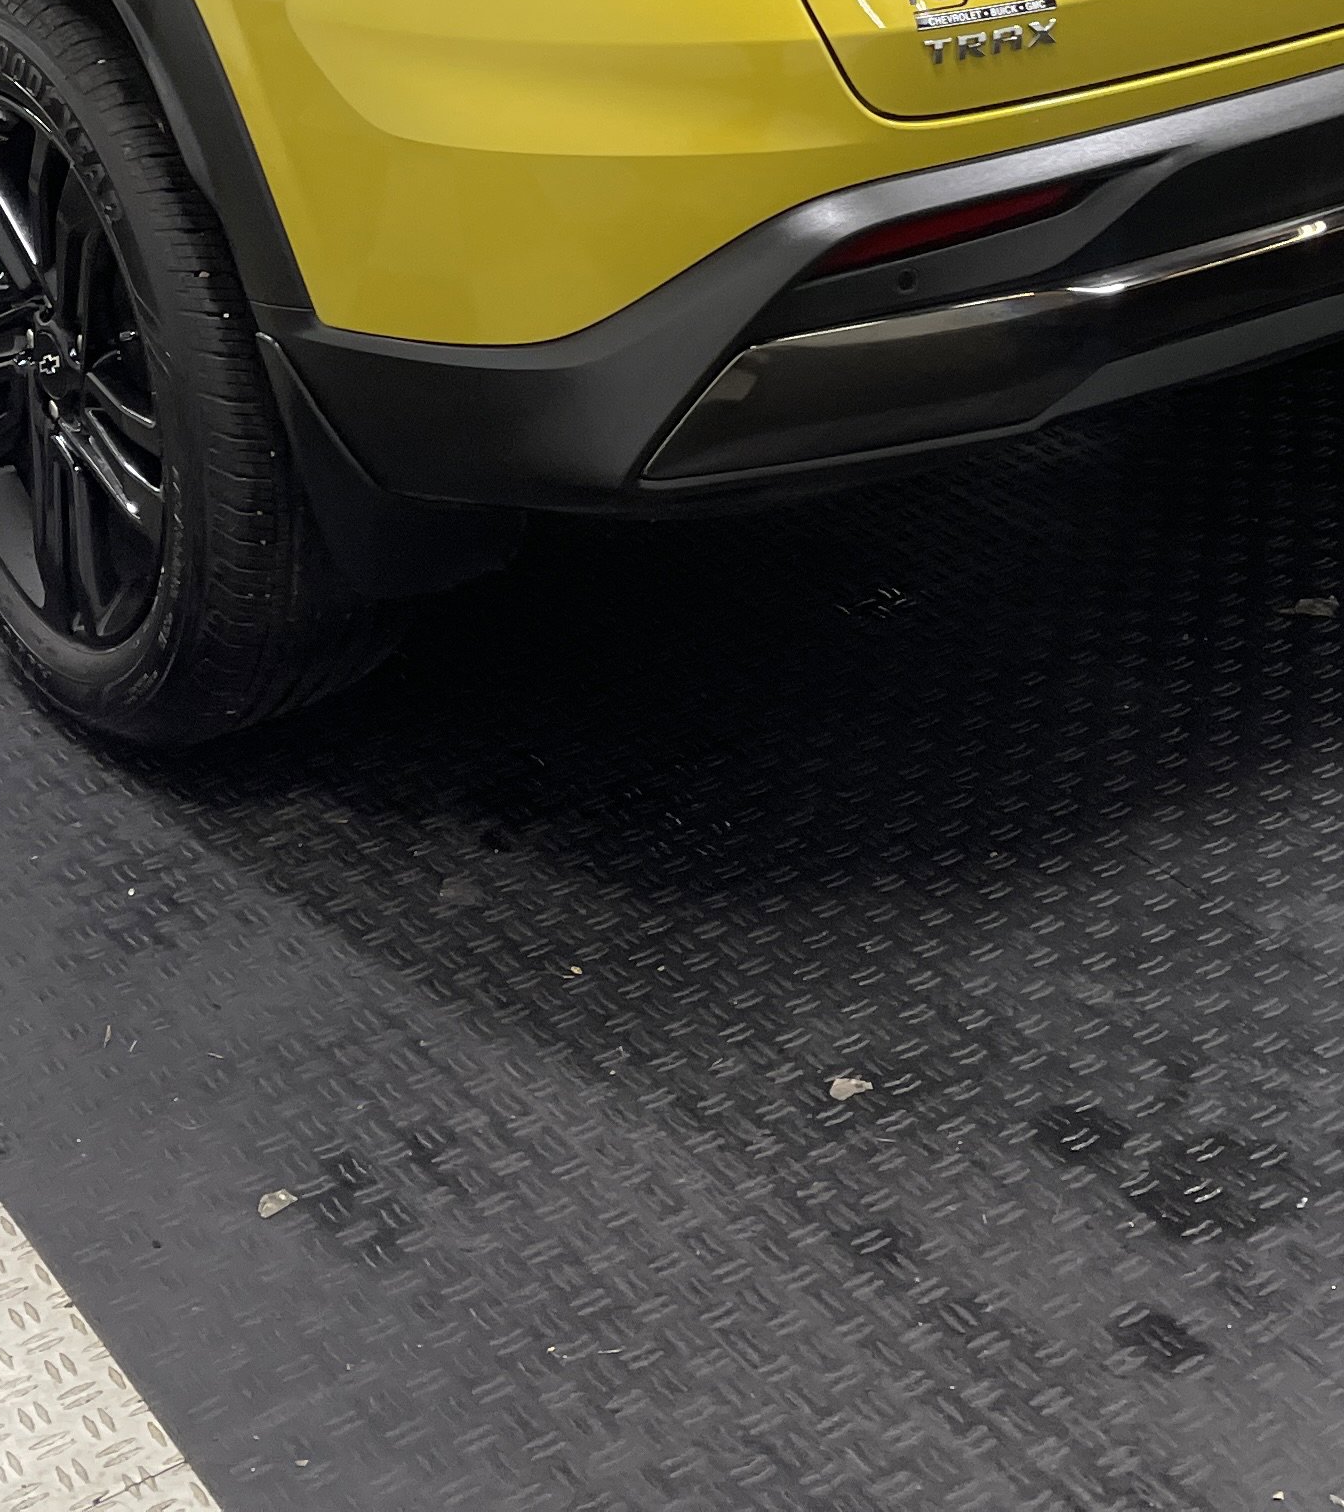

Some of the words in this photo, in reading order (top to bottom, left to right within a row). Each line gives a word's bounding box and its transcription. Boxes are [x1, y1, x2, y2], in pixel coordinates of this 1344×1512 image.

[991, 5, 1017, 16] BUICK
[1026, 0, 1047, 10] GMC
[929, 10, 982, 26] CHEVROLET
[924, 18, 1056, 64] TRAX
